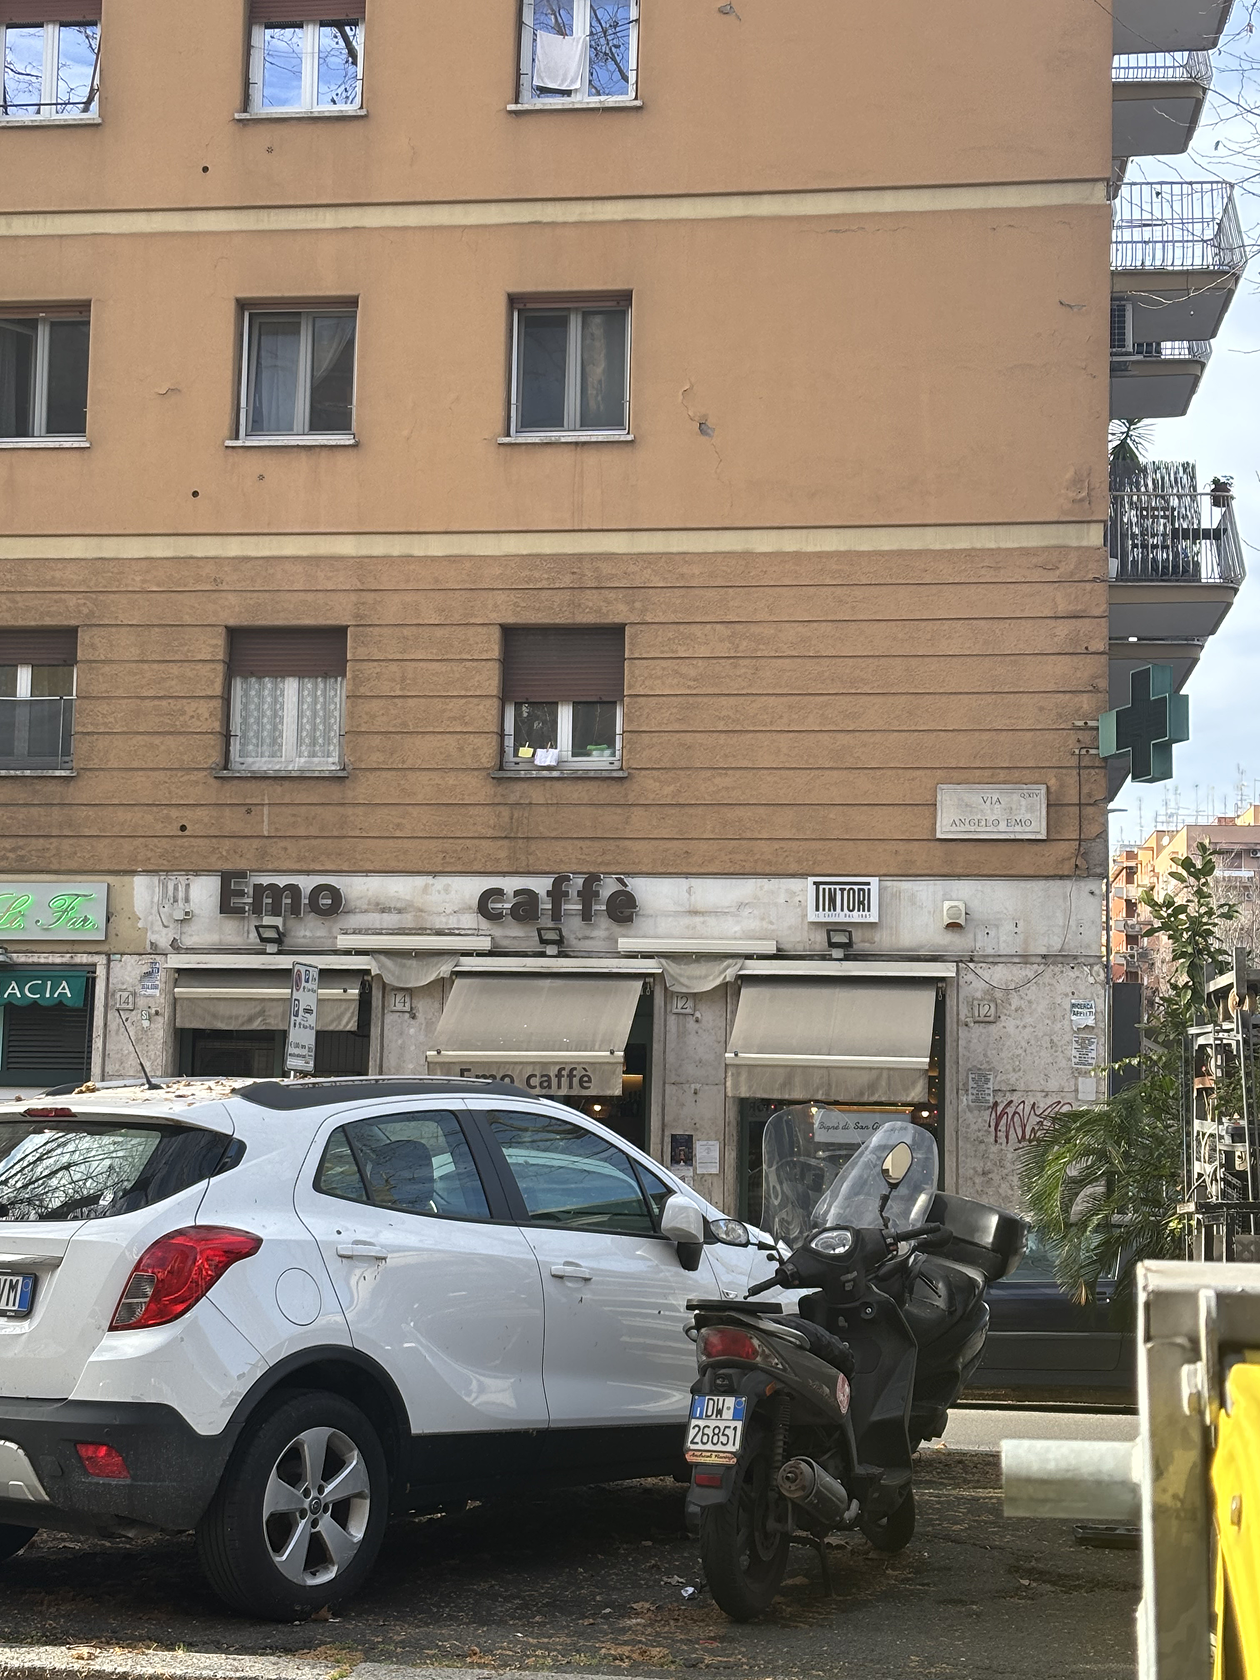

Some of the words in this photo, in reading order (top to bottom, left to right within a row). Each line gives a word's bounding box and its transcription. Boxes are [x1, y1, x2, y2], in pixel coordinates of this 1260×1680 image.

[981, 796, 1002, 805] VIA
[950, 818, 1000, 827] ANGELO
[1006, 818, 1033, 828] EMO
[219, 869, 346, 917] Emo
[477, 873, 640, 924] caffè
[813, 881, 871, 912] TINTORI
[3, 980, 72, 998] ACIA
[119, 993, 131, 1007] 14
[393, 993, 408, 1007] 14
[675, 995, 688, 1009] 12
[977, 1003, 992, 1018] 12
[526, 1067, 593, 1090] caffè
[819, 1121, 840, 1132] Bignè
[841, 1121, 850, 1130] di
[853, 1121, 870, 1130] San
[705, 1398, 725, 1418] DW
[690, 1424, 738, 1446] 26851
